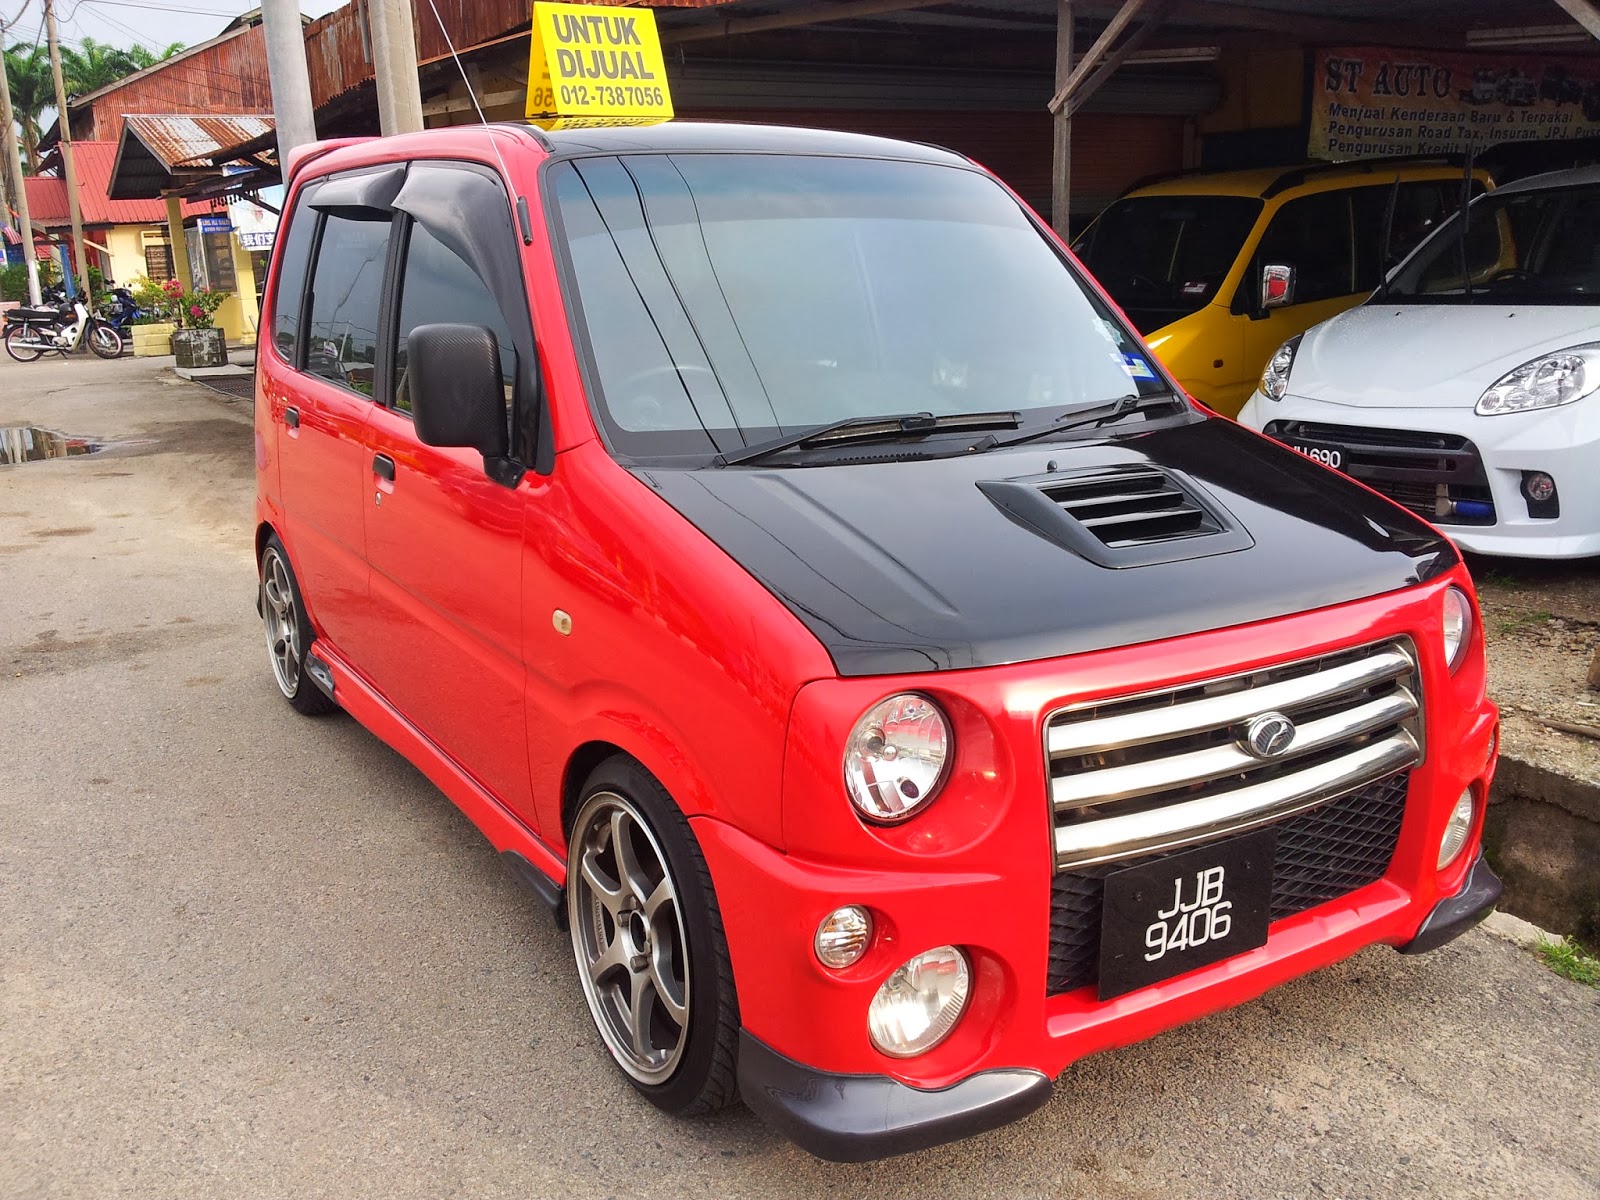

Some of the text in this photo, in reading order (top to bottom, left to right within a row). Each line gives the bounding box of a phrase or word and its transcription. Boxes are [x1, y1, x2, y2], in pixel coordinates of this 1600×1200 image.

[552, 13, 641, 45] UNTUK
[556, 49, 654, 80] DIJUAL
[1324, 57, 1452, 99] ST AUTO
[560, 84, 664, 106] 012-7387056
[1328, 102, 1573, 125] Menjual Kenderaan Baru & Terpakai
[1328, 121, 1412, 139] Pengurusan
[1418, 125, 1452, 139] Road
[1328, 138, 1412, 156] Pengurusan
[1157, 865, 1225, 920] JJB
[1144, 900, 1233, 962] 9406
